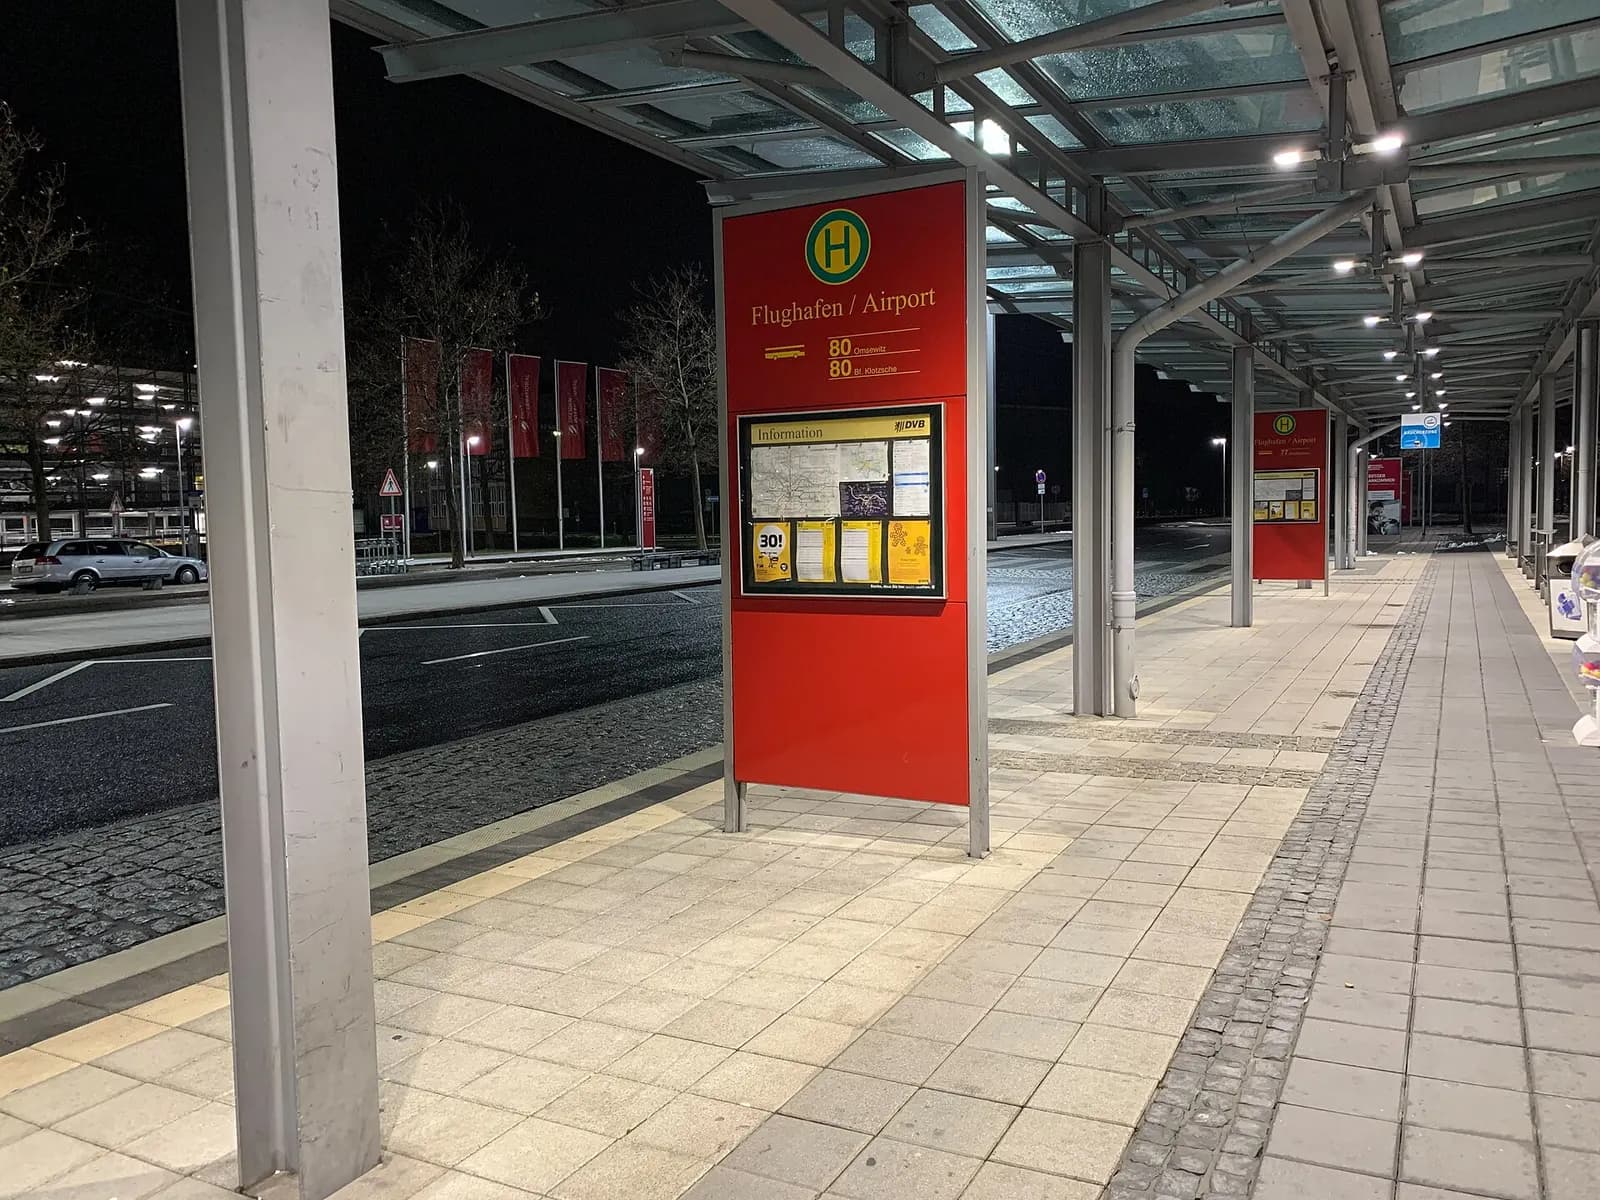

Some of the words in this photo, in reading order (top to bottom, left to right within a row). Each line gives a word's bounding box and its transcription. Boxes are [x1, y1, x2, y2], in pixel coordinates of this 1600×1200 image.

[825, 226, 850, 268] H
[751, 299, 843, 328] Flughafen
[849, 294, 857, 315] /
[862, 287, 936, 316] Airport
[829, 338, 852, 357] 80
[853, 345, 887, 355] Omsewitz
[829, 359, 852, 378] 80
[864, 366, 898, 375] Klotzsche
[757, 425, 824, 441] Information
[905, 419, 926, 430] DVB
[759, 534, 783, 548] 30!
